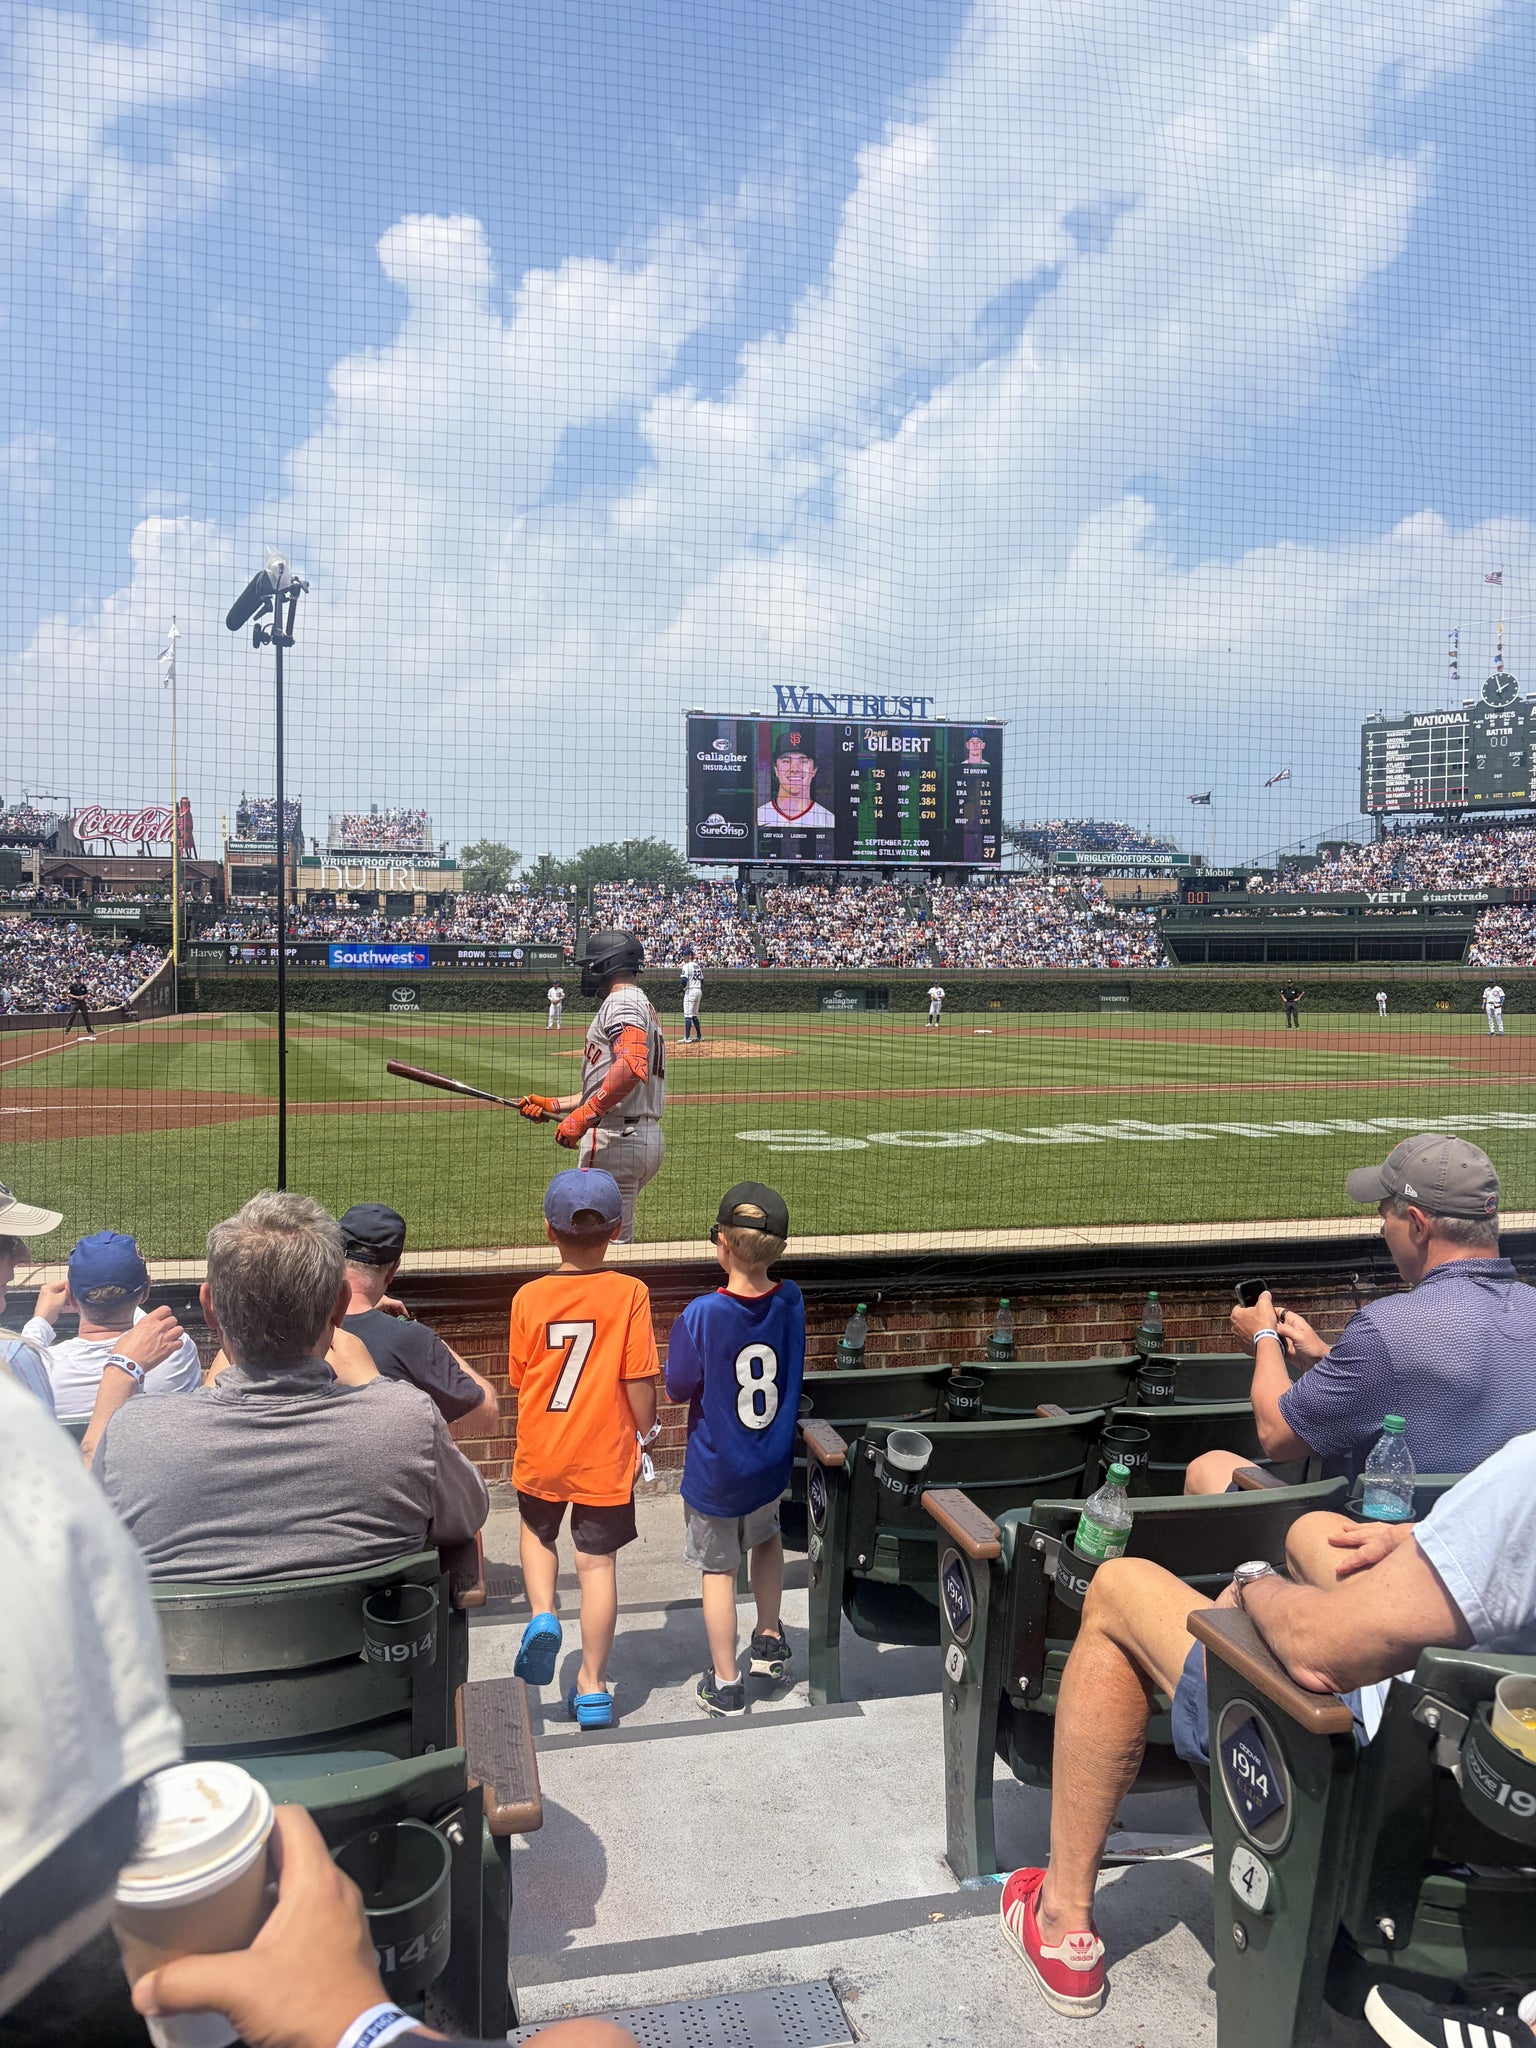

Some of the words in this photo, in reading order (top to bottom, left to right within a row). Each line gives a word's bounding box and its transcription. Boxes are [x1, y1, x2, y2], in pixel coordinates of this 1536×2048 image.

[772, 684, 934, 719] WINTRUST
[1413, 712, 1470, 727] NATIONAL
[863, 727, 889, 740] Drew
[1486, 727, 1513, 736] BATTER
[842, 741, 854, 752] CF
[867, 736, 931, 753] GILBERT
[696, 751, 748, 763] Gallagher
[1512, 756, 1521, 767] 2
[702, 764, 742, 772] INSURANCE
[1477, 759, 1486, 770] 2
[871, 769, 886, 778] 125
[919, 770, 937, 779] .240
[875, 782, 881, 791] 3
[919, 783, 937, 793] .286
[873, 796, 883, 805] 12
[918, 797, 936, 806] .384
[873, 809, 884, 818] 14
[918, 810, 936, 819] .670
[864, 838, 902, 847] SEPTEMBER
[913, 839, 930, 847] 2000
[920, 849, 931, 857] MN
[983, 847, 996, 859] 37
[1075, 852, 1173, 864] WRIGLEYROOFTOPS.COM
[320, 857, 440, 869] WRIGLEYROOFTOPS.COM
[1204, 868, 1234, 877] Mobile
[1187, 891, 1210, 904] 0:07
[1366, 892, 1406, 903] YETI
[1429, 891, 1489, 903] tastytrade
[94, 907, 141, 915] GRAINGER
[190, 948, 224, 959] Harvey
[333, 949, 414, 965] Southwest
[458, 950, 486, 958] BROWN
[822, 997, 858, 1005] Gallagher
[1435, 1000, 1450, 1009] 400
[546, 1319, 597, 1412] 7
[734, 1341, 780, 1432] 8
[1151, 1385, 1174, 1396] 1914
[956, 1396, 980, 1408] 1914
[1118, 1451, 1148, 1466] 1914
[887, 1478, 919, 1496] 1914
[947, 1579, 963, 1610] 1914
[383, 1632, 433, 1662] 1914
[950, 1652, 958, 1673] 3
[1232, 1748, 1269, 1798] 1914
[1242, 1865, 1255, 1893] 4
[1069, 1954, 1094, 1962] adidas
